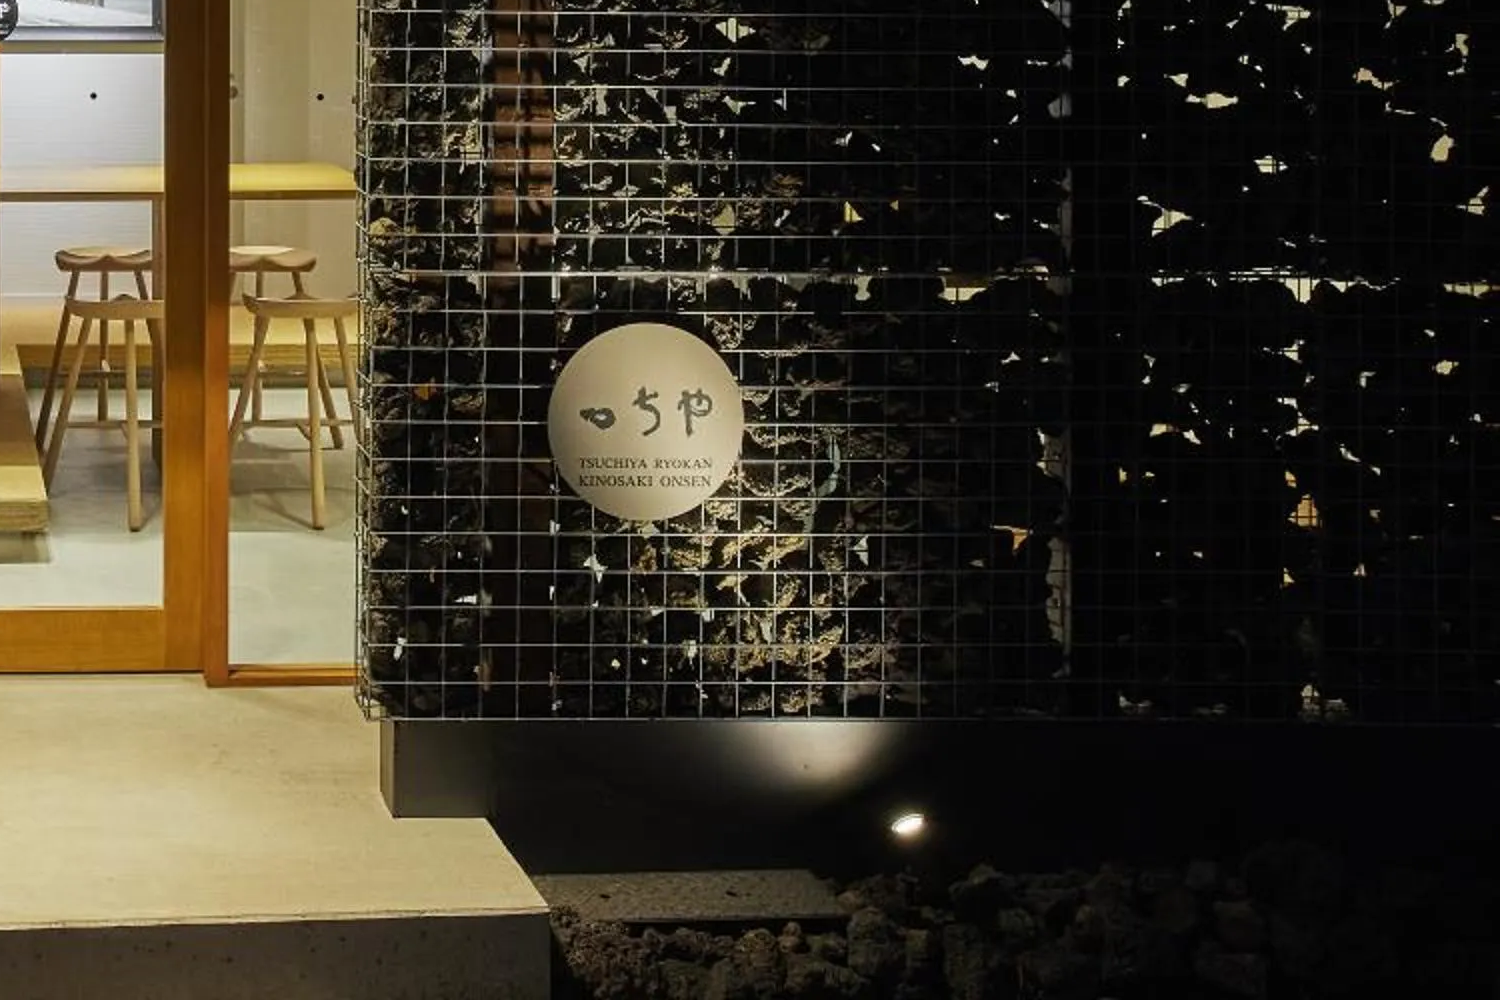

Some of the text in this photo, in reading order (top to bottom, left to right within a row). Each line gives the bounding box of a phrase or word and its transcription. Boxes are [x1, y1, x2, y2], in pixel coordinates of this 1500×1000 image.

[579, 457, 713, 469] TSUCHIYA RYOKAN
[579, 475, 712, 487] KINOSAKI ONSEN
